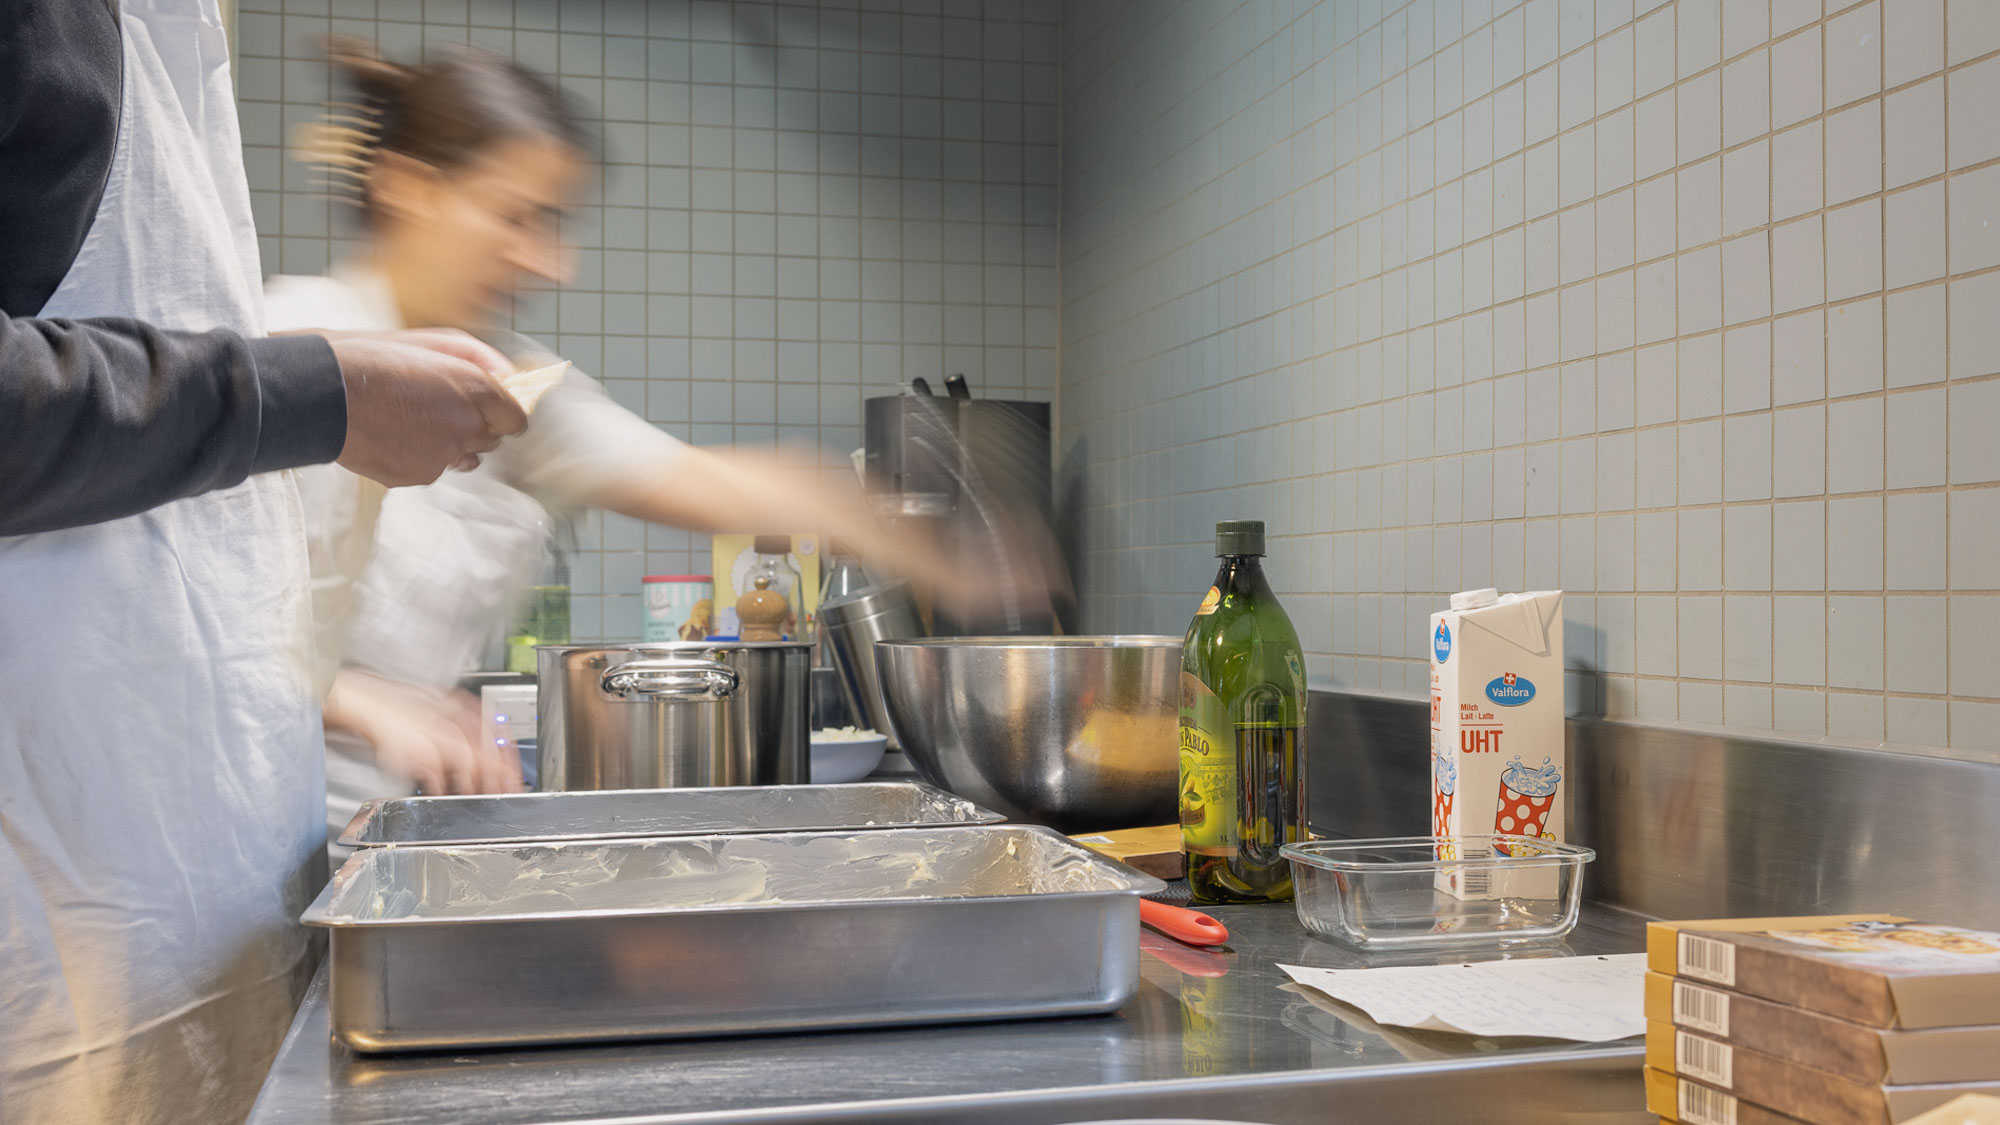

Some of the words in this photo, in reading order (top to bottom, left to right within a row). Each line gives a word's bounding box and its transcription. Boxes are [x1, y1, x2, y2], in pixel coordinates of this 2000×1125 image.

[1491, 687, 1530, 697] Valflora
[1460, 712, 1474, 720] Lait
[1478, 712, 1494, 720] Latte
[1185, 728, 1209, 756] PABLO
[1461, 730, 1504, 753] UHT
